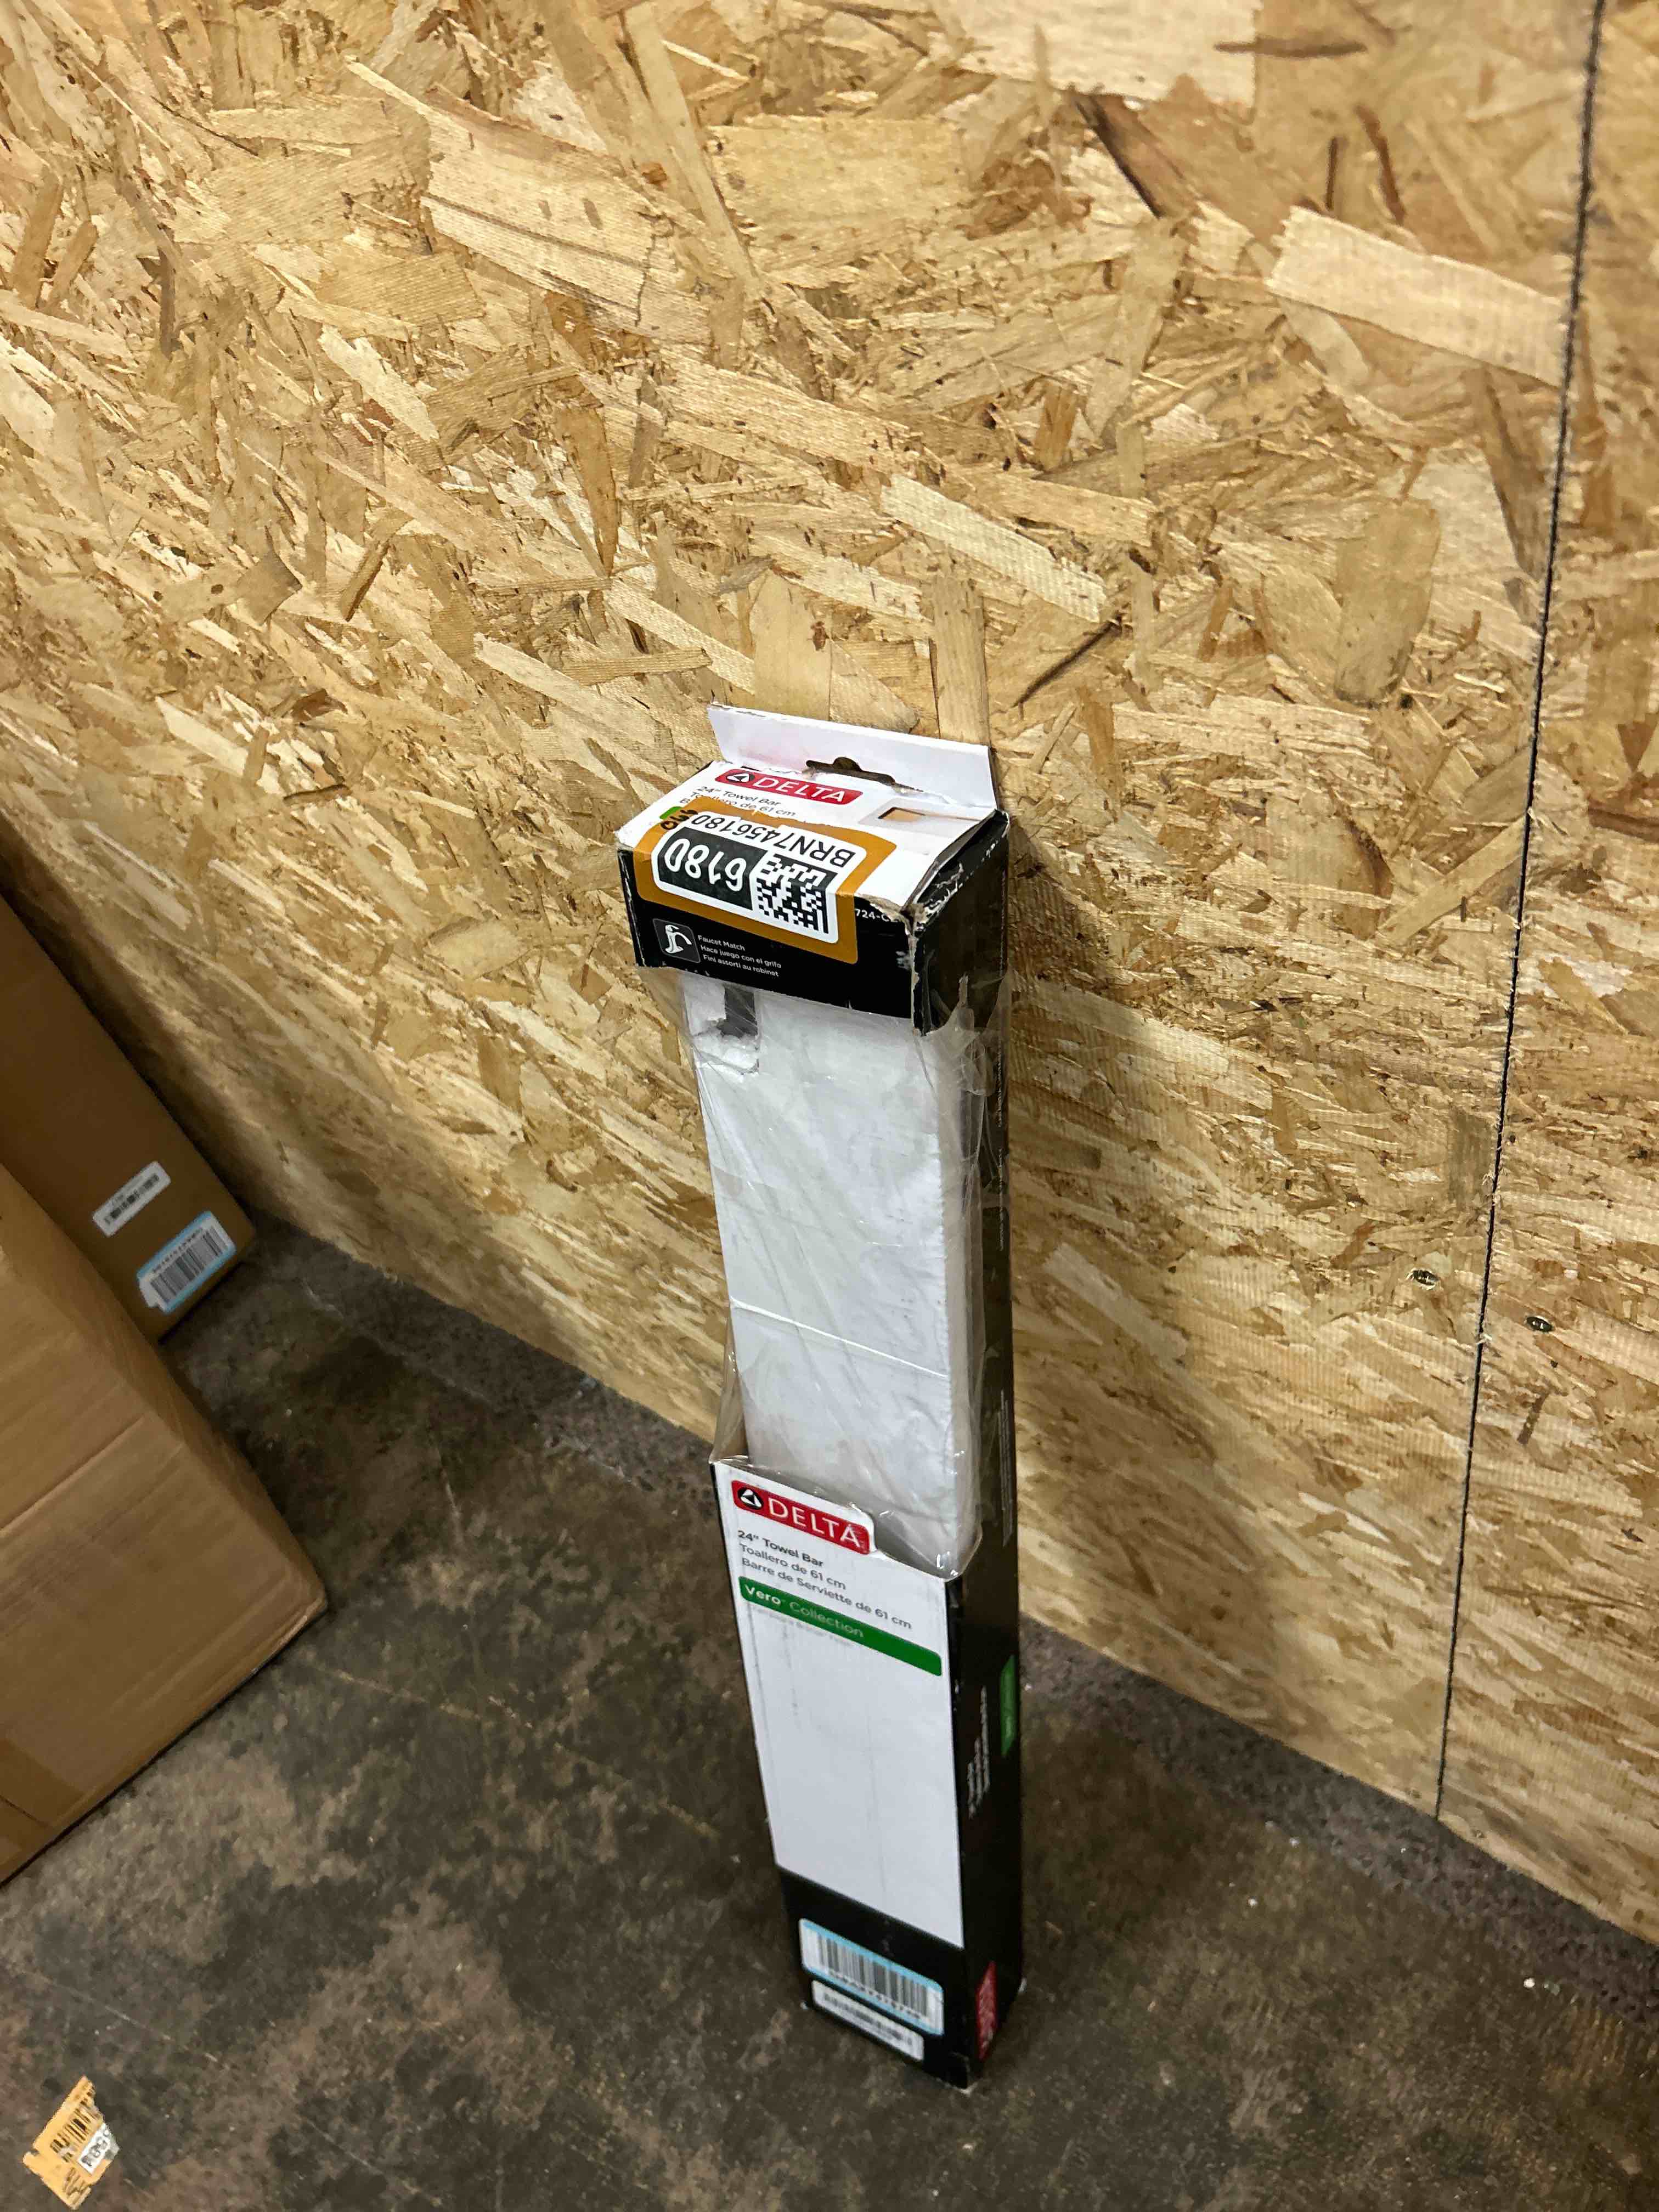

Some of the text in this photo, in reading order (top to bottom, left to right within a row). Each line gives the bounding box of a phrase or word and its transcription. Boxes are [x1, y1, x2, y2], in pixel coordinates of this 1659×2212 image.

[723, 791, 758, 802] Towel
[759, 798, 782, 806] Bar
[753, 776, 846, 802] DELTA
[740, 802, 757, 810] de
[691, 815, 856, 867] BRN7456180
[664, 838, 747, 891] 6180
[855, 908, 896, 922] 724-C
[697, 935, 746, 951] Faucet Match
[700, 945, 718, 954] Hace
[719, 949, 740, 959] juego
[741, 955, 755, 963] con
[764, 960, 782, 968] grifo
[703, 954, 716, 963] Fini
[717, 958, 741, 968] assorti
[753, 967, 779, 977] robinet
[768, 1498, 861, 1548] DELTA
[737, 1530, 823, 1567] 24" Towel Bar
[739, 1543, 846, 1590] Toallero de 61 cm
[742, 1558, 912, 1629] Barre de Serviette de 61 cm
[744, 1584, 782, 1607] Vero
[789, 1601, 864, 1638] Collection
